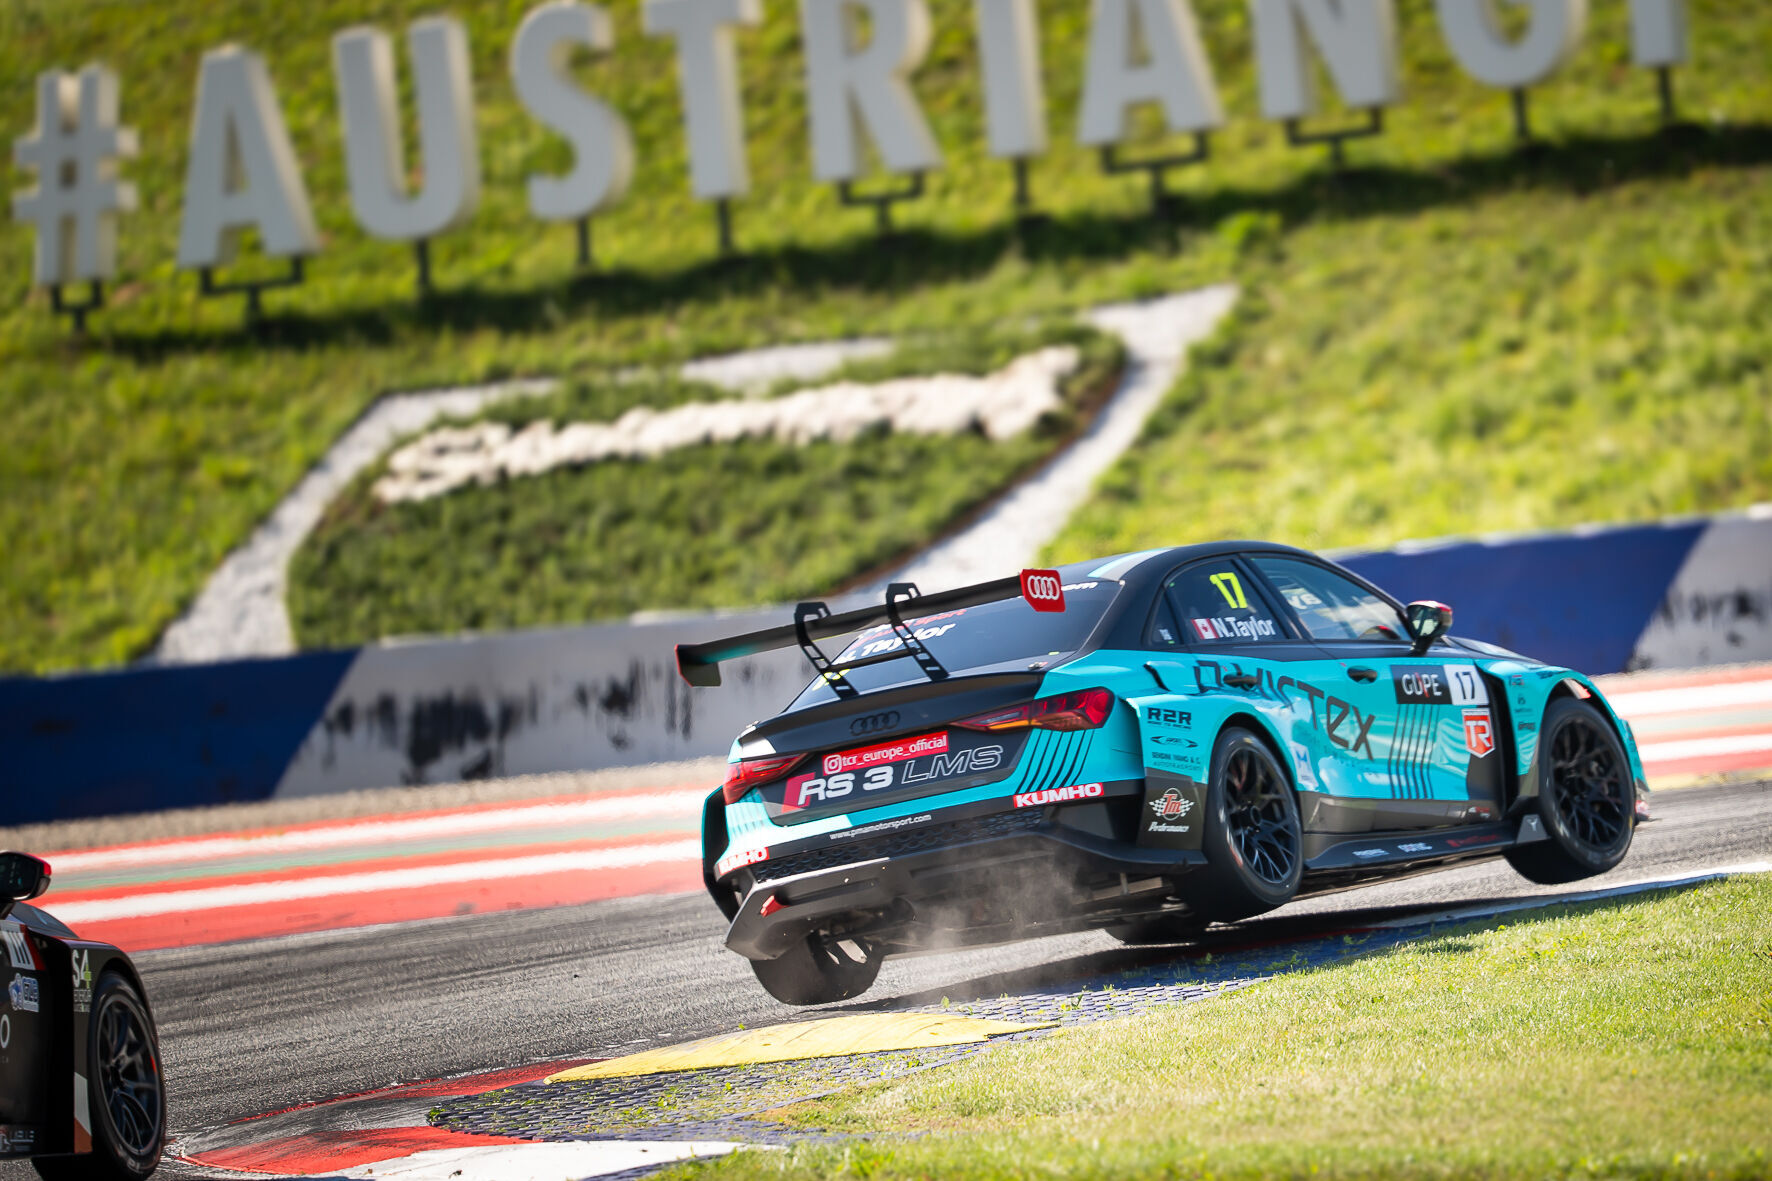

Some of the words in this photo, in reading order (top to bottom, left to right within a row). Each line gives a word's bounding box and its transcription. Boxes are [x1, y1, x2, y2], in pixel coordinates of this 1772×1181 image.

[1209, 572, 1248, 609] 17
[1211, 616, 1276, 641] N.Taylor
[1455, 671, 1476, 700] 17
[1147, 707, 1192, 726] R2R
[842, 734, 948, 768] tcr_europe_official
[798, 773, 855, 806] RS
[862, 766, 894, 791] 3
[901, 744, 1003, 785] LMS
[1016, 783, 1102, 808] KUMHO
